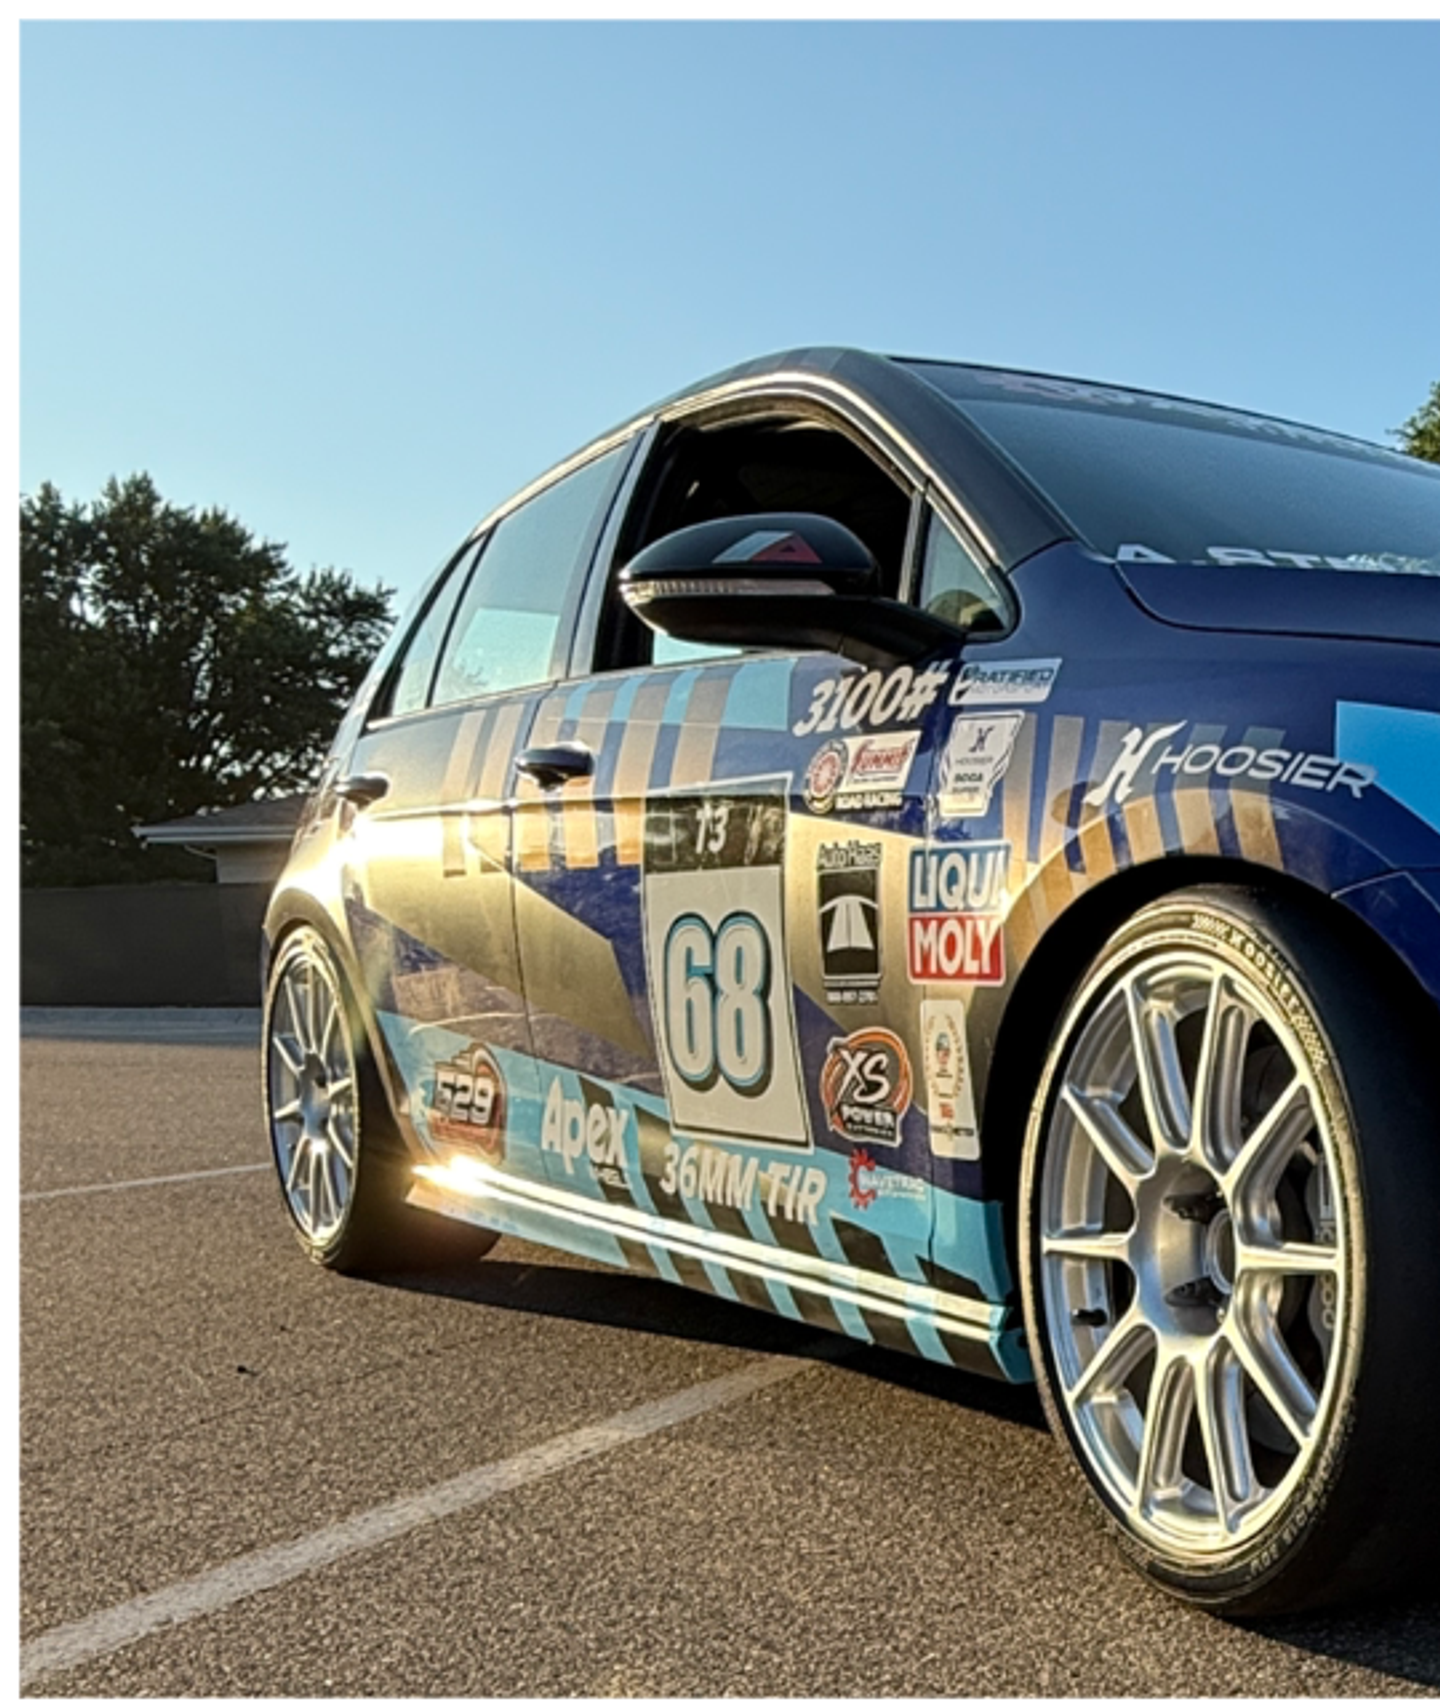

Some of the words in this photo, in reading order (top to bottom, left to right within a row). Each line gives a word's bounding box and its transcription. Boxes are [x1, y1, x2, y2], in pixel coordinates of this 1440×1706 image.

[793, 659, 950, 737] 3100#
[1151, 744, 1379, 798] HOOSIER
[912, 917, 1001, 976] MOLY
[664, 910, 773, 1099] 68
[836, 1047, 891, 1105] XS
[540, 1075, 630, 1175] Apex
[841, 1105, 896, 1129] POWER
[659, 1142, 760, 1211] 36MM
[767, 1159, 828, 1226] TIR
